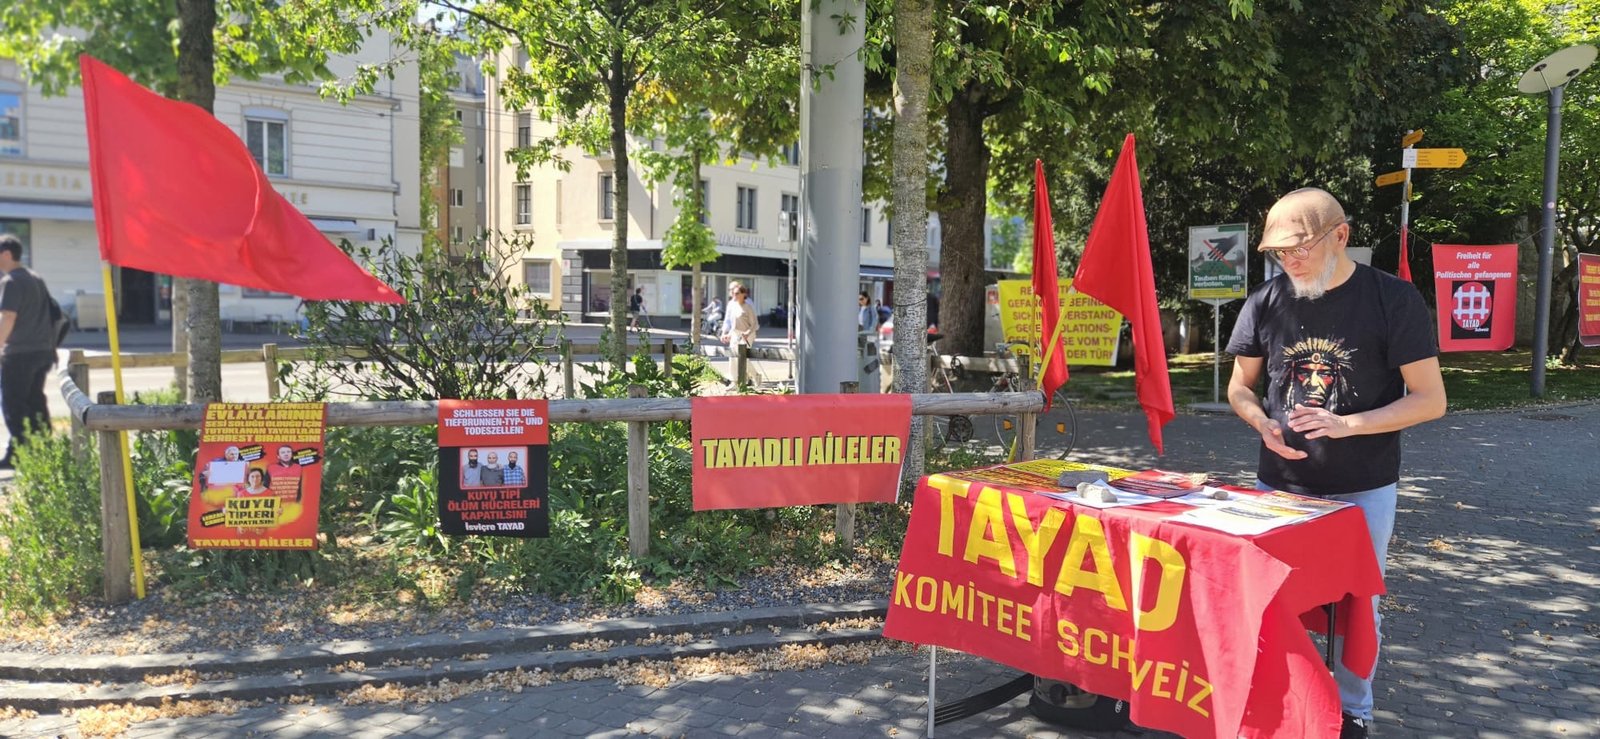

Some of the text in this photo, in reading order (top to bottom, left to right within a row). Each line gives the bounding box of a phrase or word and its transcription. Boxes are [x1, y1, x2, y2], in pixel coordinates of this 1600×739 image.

[1482, 252, 1493, 260] für
[1467, 261, 1480, 269] alle
[1436, 271, 1512, 280] Politischen gefangenen
[1462, 319, 1480, 328] TAYAD
[1076, 336, 1100, 346] VOM
[1067, 350, 1087, 359] DER
[206, 409, 324, 420] EVLATLARININ
[453, 408, 535, 418] SCHLIESSEN SIE DIE
[525, 417, 544, 426] UND
[464, 426, 525, 436] TODESZELLEN!
[701, 431, 902, 469] TAYADLI AİLELER
[467, 491, 497, 501] KUYU
[228, 499, 275, 509] KUYU
[447, 500, 479, 512] ÖLÜM
[461, 510, 528, 521] KAPATILSIN!
[497, 522, 525, 531] TAYAD
[927, 474, 1187, 632] TAYAD
